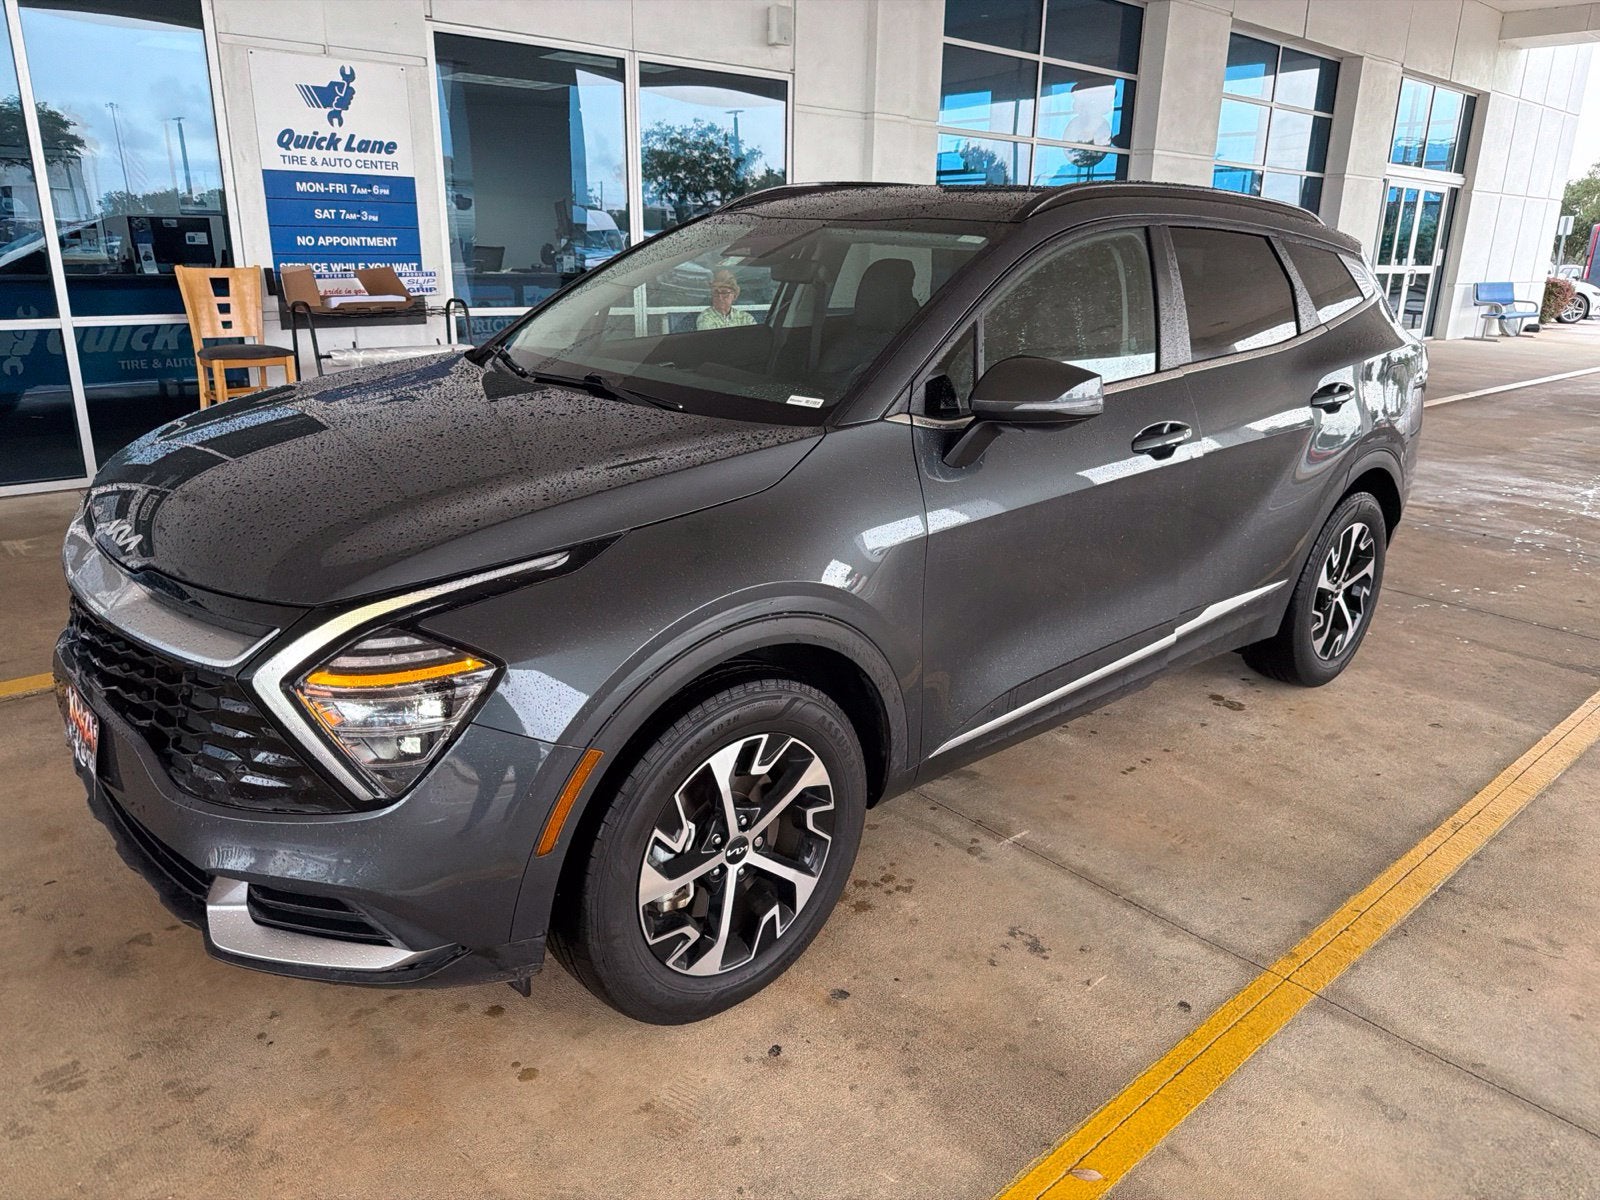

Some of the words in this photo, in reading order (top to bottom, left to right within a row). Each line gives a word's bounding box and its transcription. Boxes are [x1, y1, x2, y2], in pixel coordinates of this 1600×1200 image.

[277, 128, 342, 151] Quick
[344, 134, 398, 155] Lane
[280, 155, 307, 165] TIRE
[310, 157, 318, 166] &
[321, 157, 352, 168] AUTO
[355, 159, 399, 171] CENTER
[295, 182, 347, 194] MON-FRI
[314, 209, 336, 219] SAT
[296, 236, 314, 246] NO
[317, 236, 398, 247] APPOINTMENT
[391, 262, 419, 273] WAIT
[119, 359, 148, 370] TIRE
[152, 359, 162, 369] &
